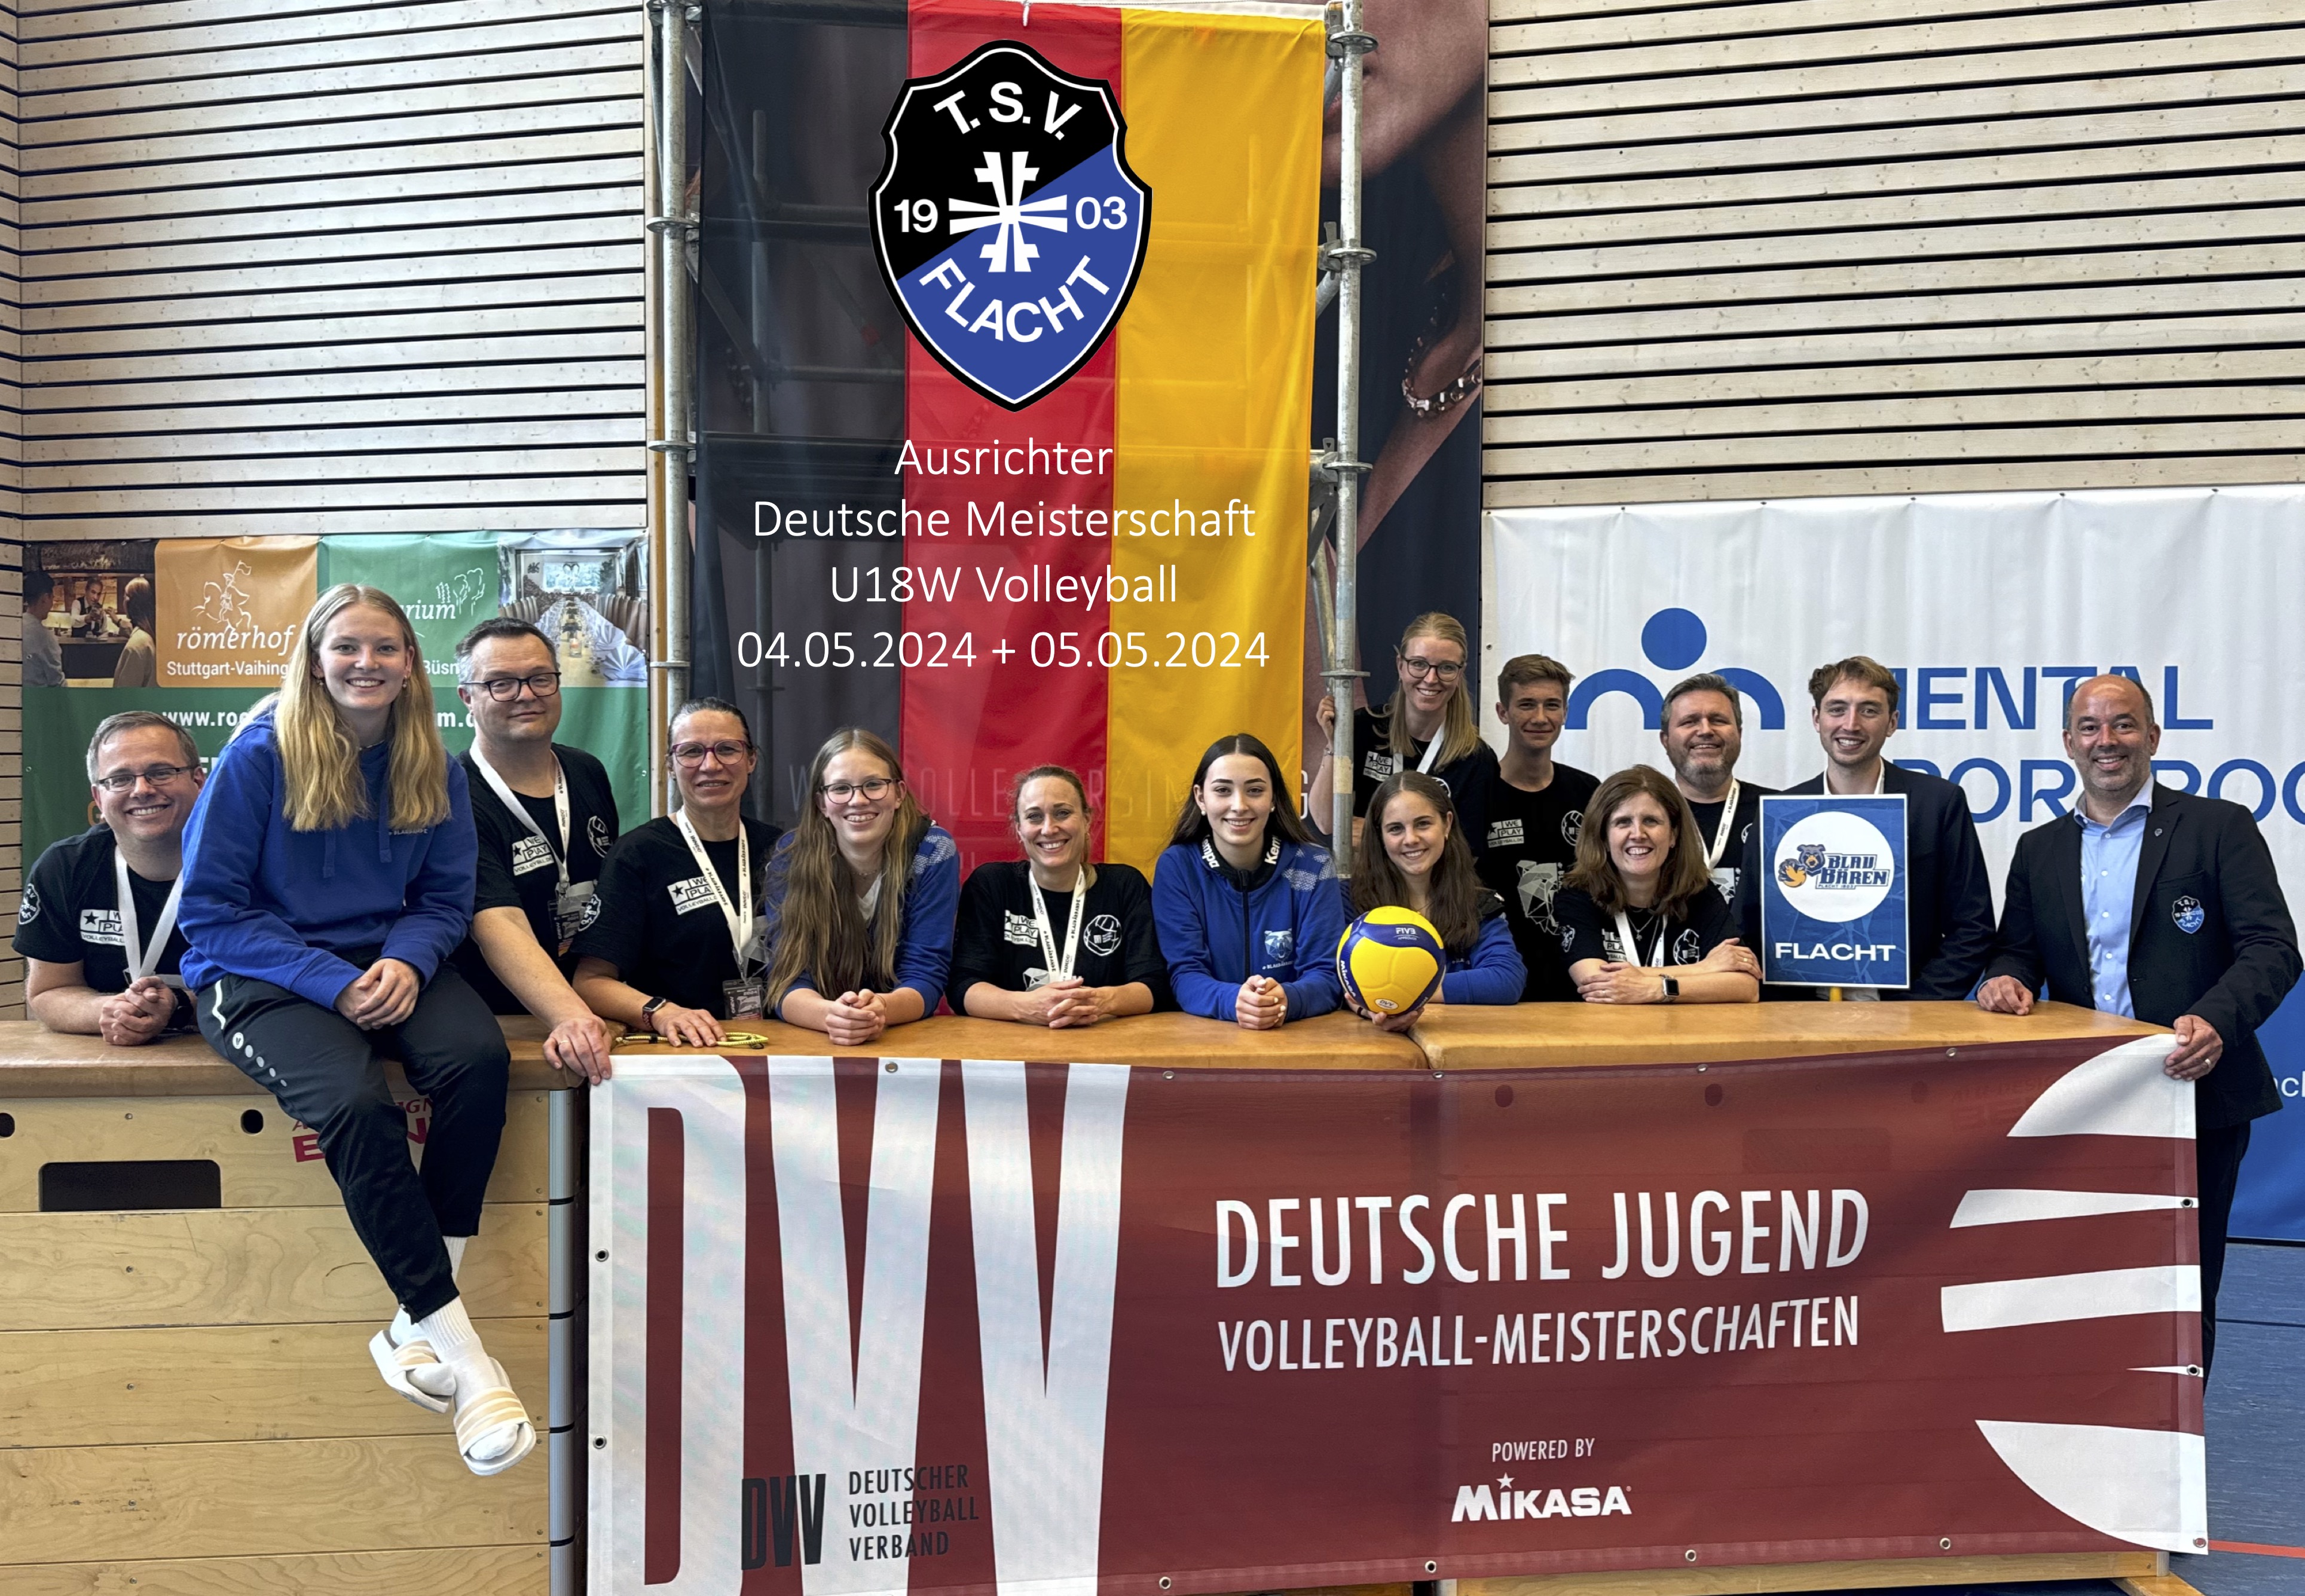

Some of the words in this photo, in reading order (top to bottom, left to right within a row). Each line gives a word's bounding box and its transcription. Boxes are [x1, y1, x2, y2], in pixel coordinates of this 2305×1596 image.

[401, 600, 456, 619] rium
[177, 625, 296, 656] römerhof
[1819, 867, 1887, 885] BÄREN
[1828, 854, 1875, 869] BLAU
[690, 886, 712, 898] PLA
[1775, 943, 1896, 961] FLACHT
[1216, 1193, 1570, 1288] DEUTSCHE
[1602, 1189, 1869, 1279] JUGEND
[589, 1054, 1132, 1596] DVV
[1218, 1295, 1859, 1371] VOLLEYBALL-MEISTERSCHAFTEN
[1492, 1439, 1568, 1462] POWERED
[1575, 1438, 1595, 1457] BY
[849, 1464, 969, 1494] DEUTSCHER
[741, 1473, 826, 1570] DVV
[849, 1496, 979, 1528] VOLLEYBALL
[849, 1531, 949, 1561] VERBAND
